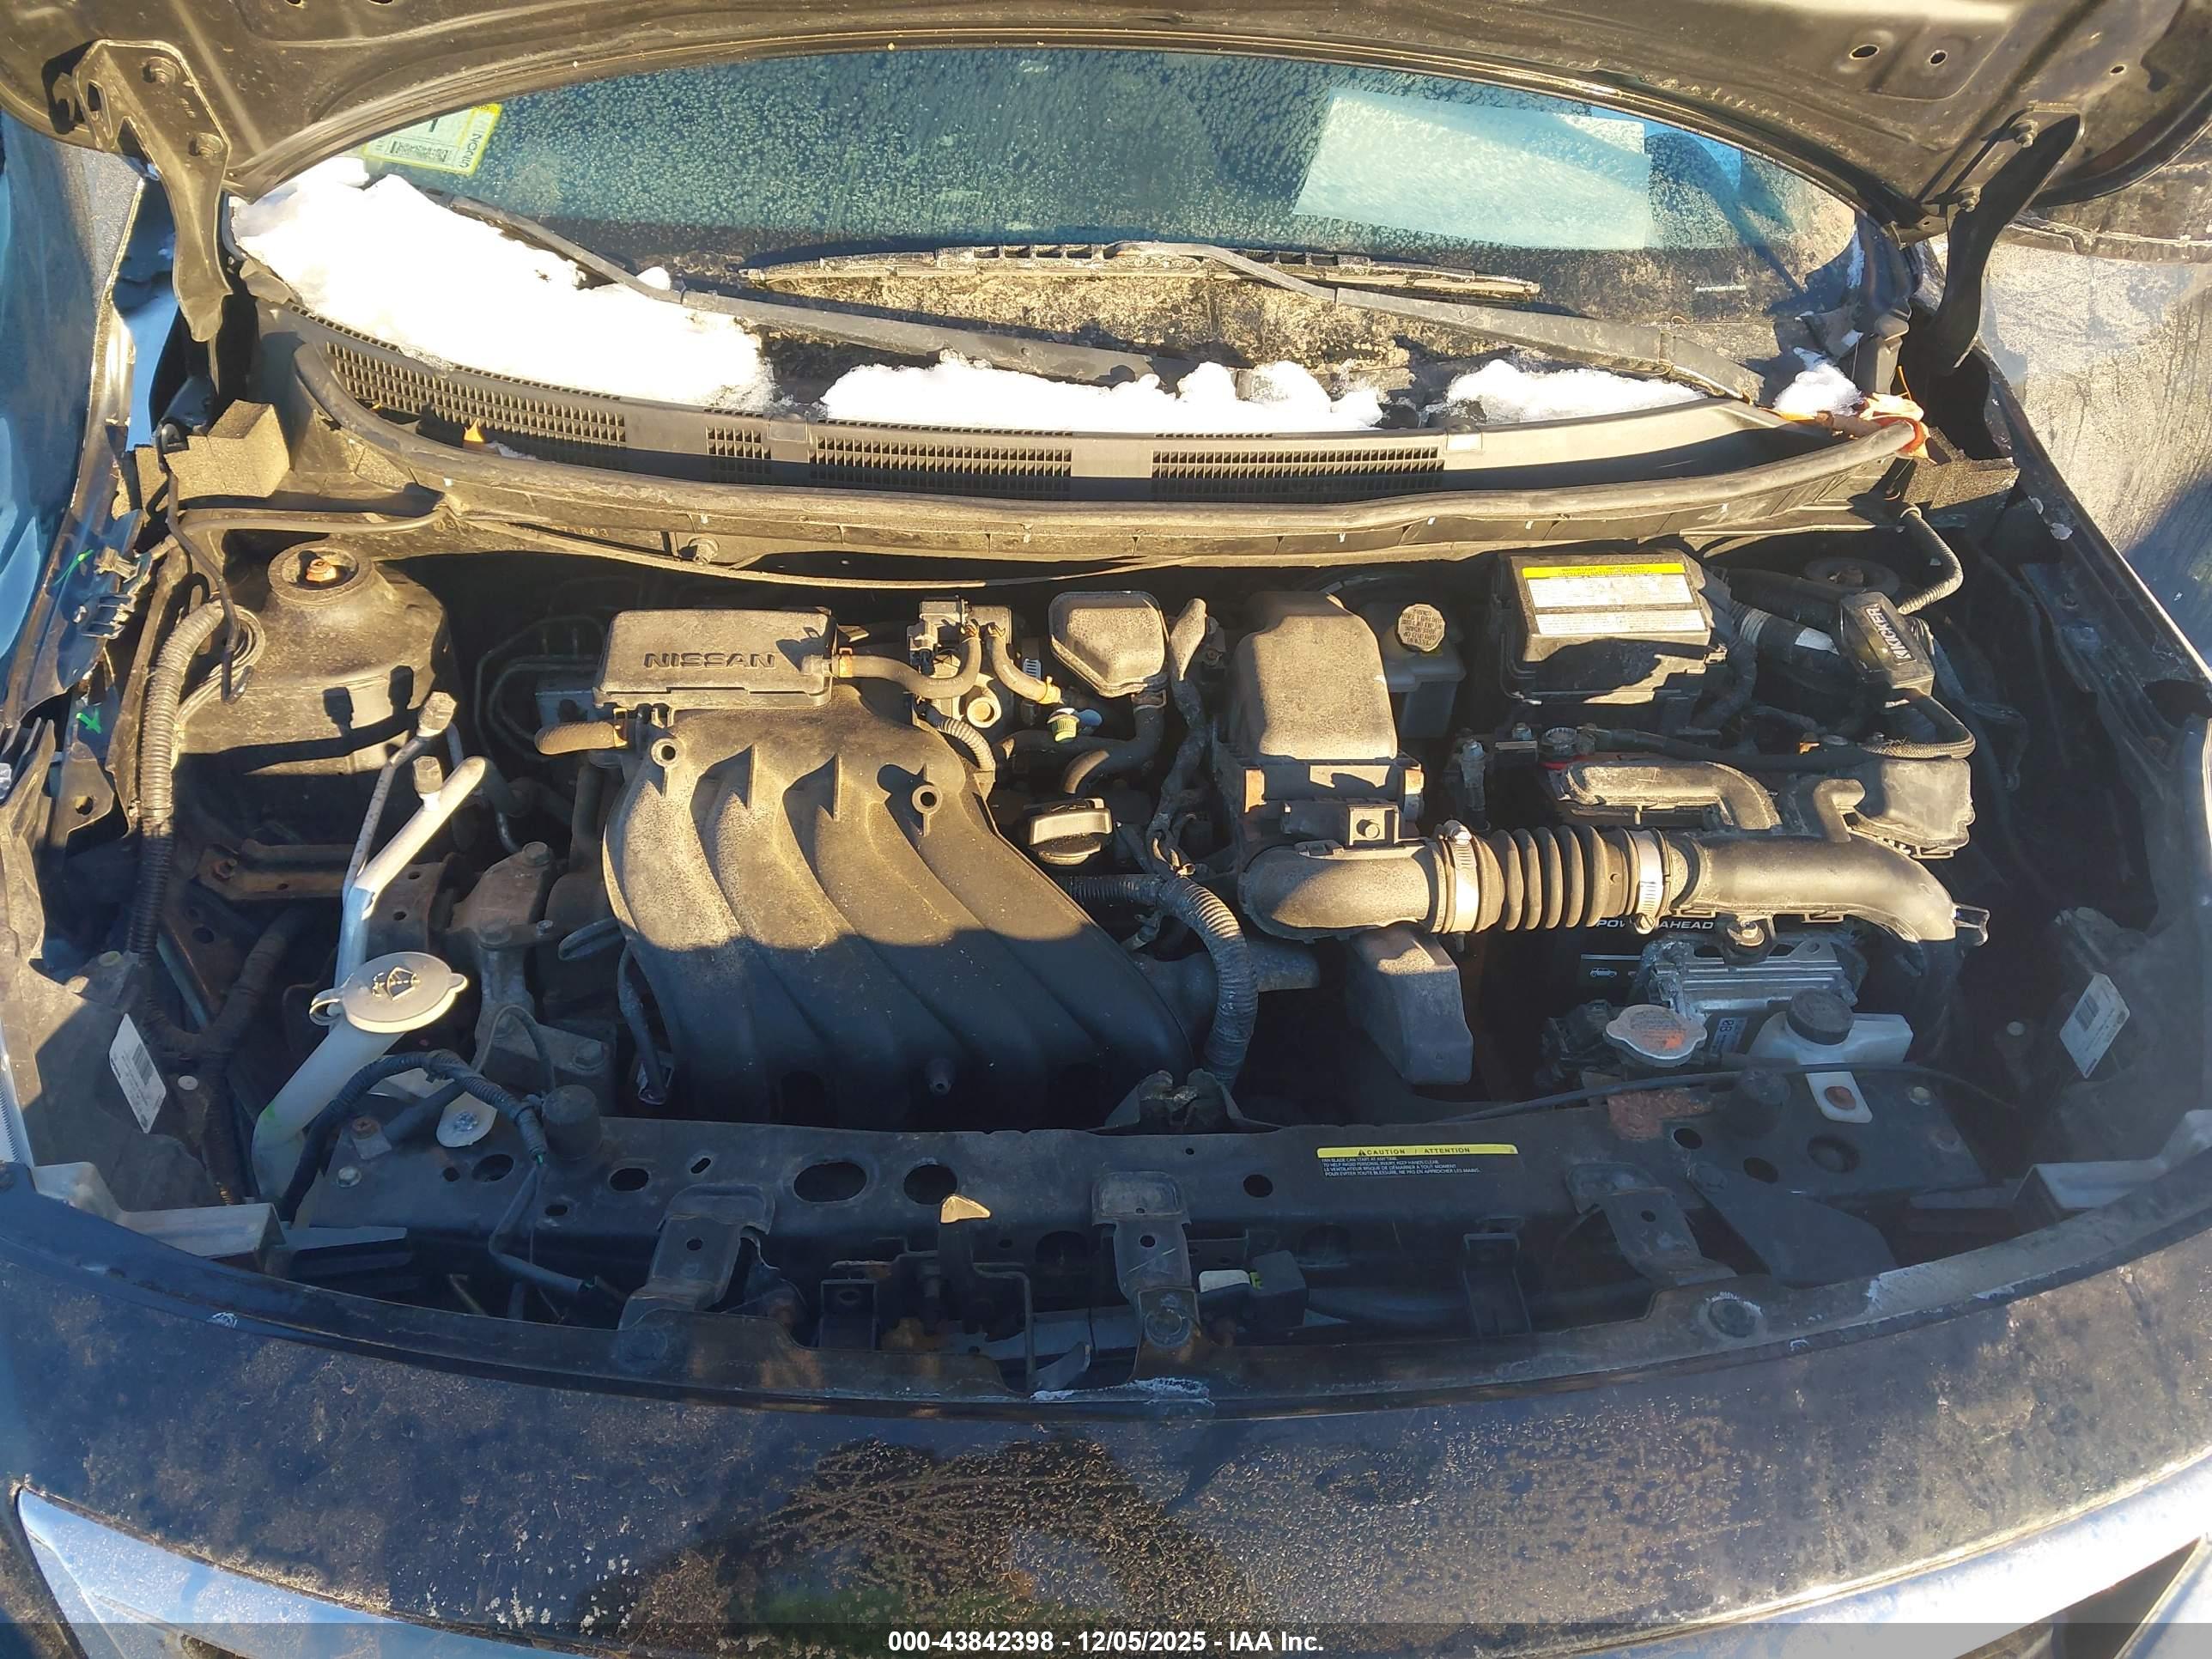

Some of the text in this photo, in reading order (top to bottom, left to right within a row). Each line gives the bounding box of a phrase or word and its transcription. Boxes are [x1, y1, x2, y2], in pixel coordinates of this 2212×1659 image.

[459, 133, 482, 168] 2025
[1866, 603, 1911, 660] KICKER
[644, 652, 775, 668] NISSAN
[1658, 921, 1714, 929] AHEAD
